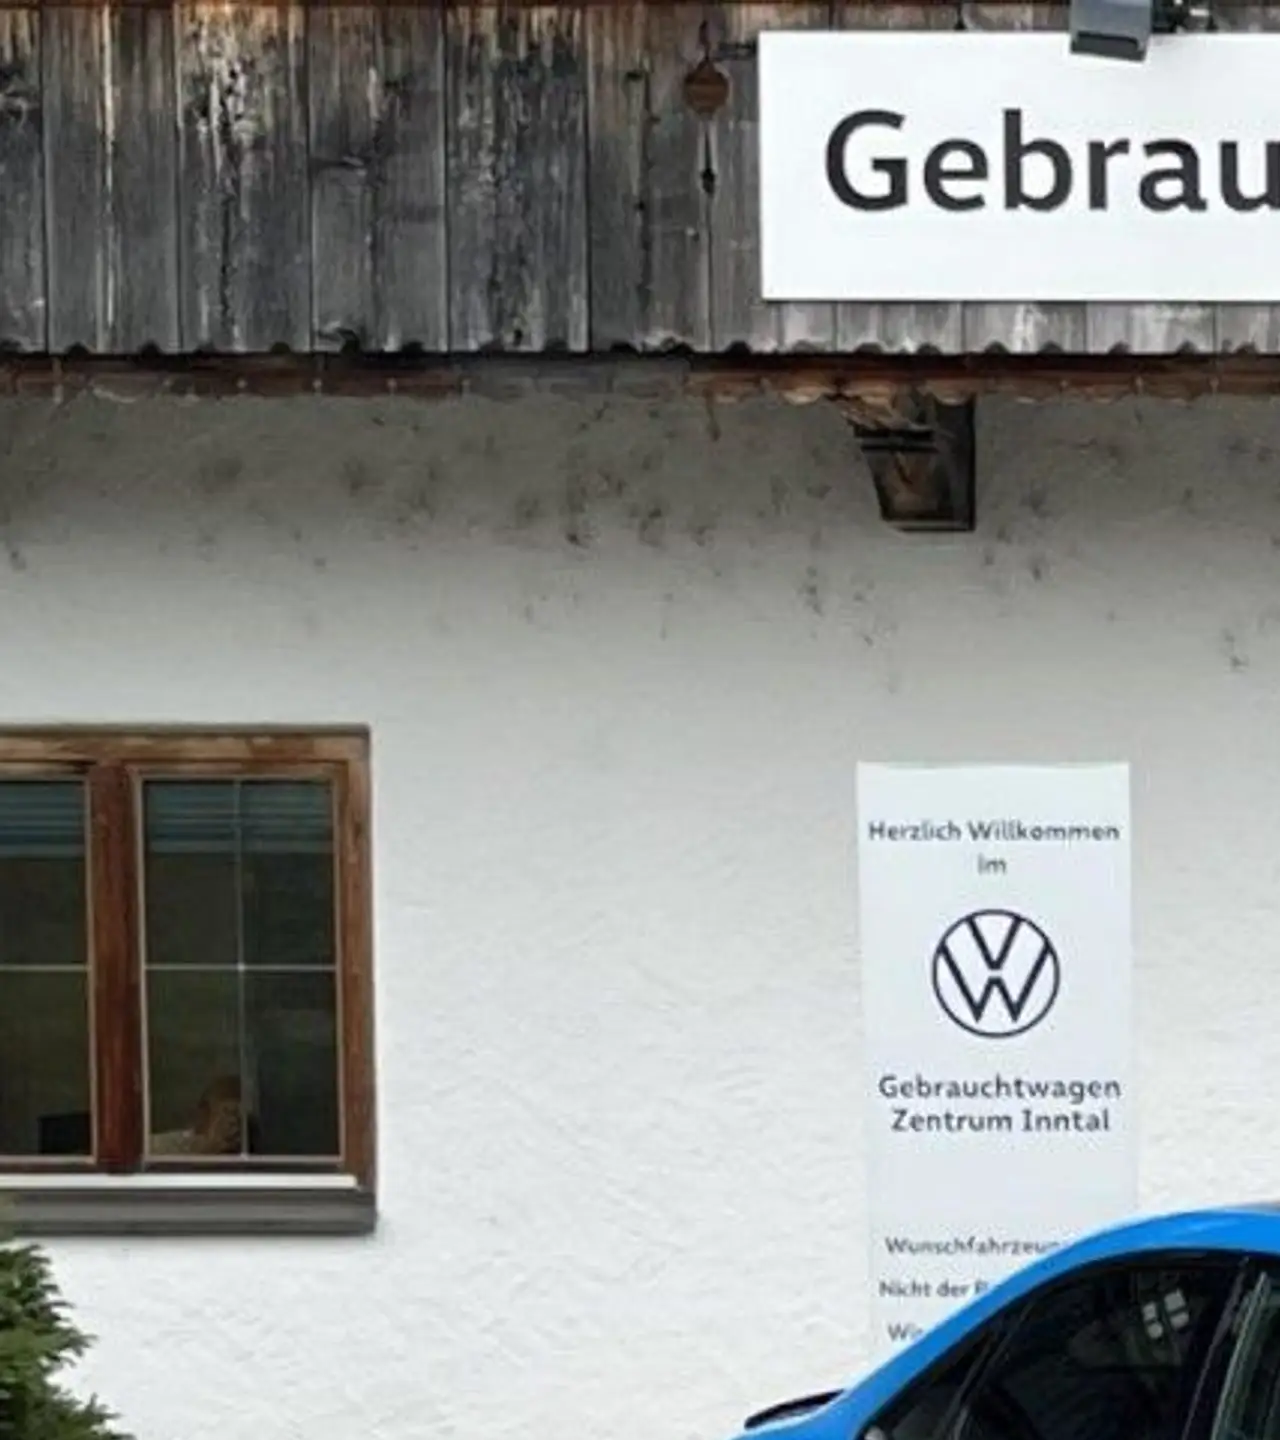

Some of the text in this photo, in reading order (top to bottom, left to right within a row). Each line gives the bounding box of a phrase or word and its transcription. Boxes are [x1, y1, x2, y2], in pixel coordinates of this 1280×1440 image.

[868, 819, 1121, 842] Herzlich Willkommen
[977, 855, 1008, 874] im
[878, 1073, 1122, 1103] Gebrauchtwagen
[891, 1107, 1110, 1133] Zentrum Inntal
[879, 1280, 931, 1297] Nicht
[936, 1279, 969, 1297] der
